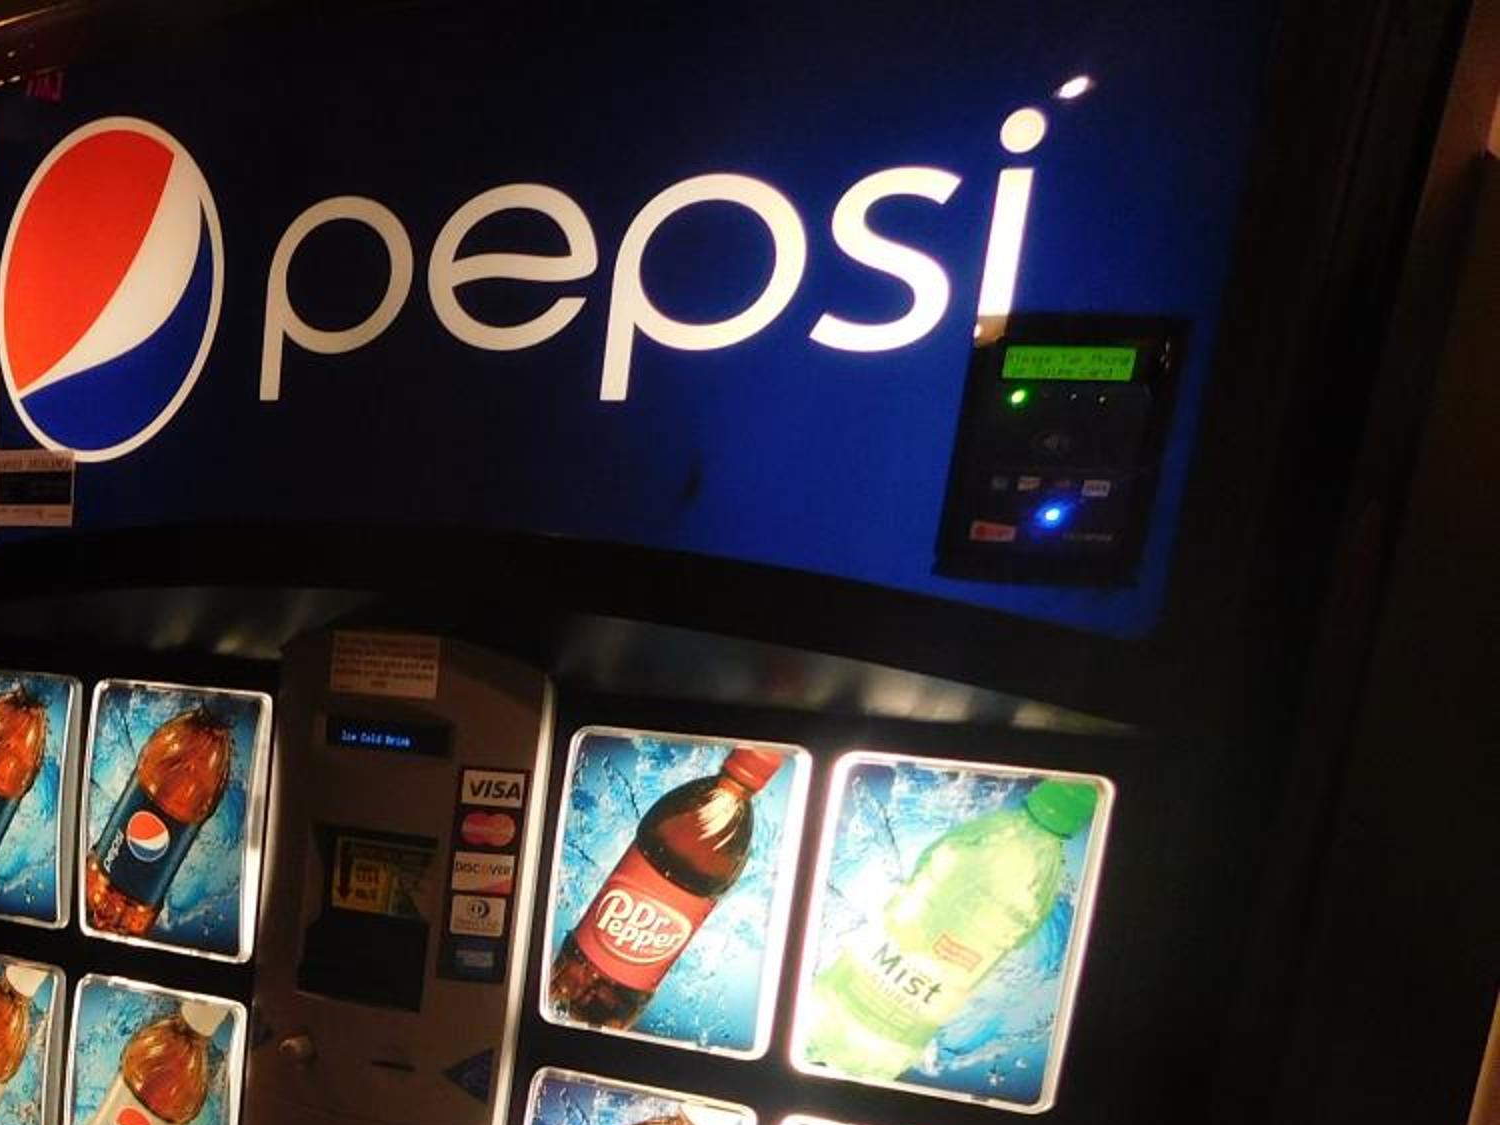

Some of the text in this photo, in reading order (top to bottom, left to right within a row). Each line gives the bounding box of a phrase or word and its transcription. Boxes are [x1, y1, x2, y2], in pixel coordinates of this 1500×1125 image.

[260, 107, 1047, 401] pepsi
[469, 779, 521, 800] VISA
[596, 893, 684, 951] Pepper
[631, 904, 670, 930] Dr
[872, 943, 943, 1005] Mist
